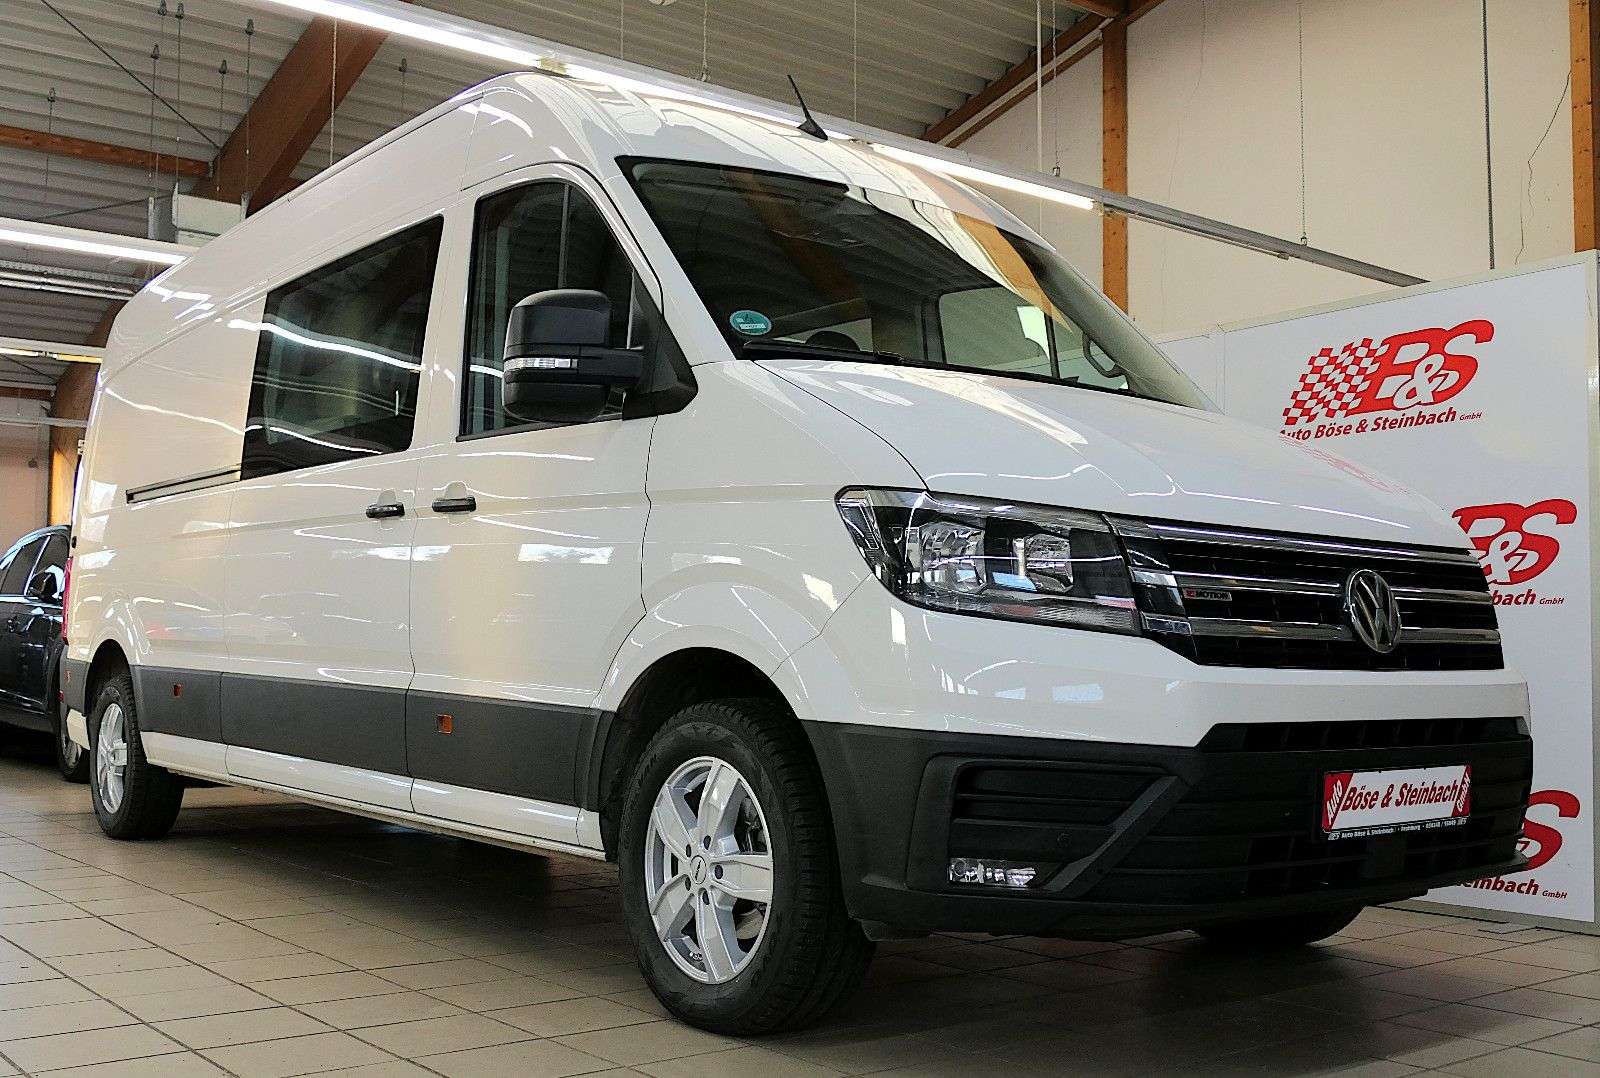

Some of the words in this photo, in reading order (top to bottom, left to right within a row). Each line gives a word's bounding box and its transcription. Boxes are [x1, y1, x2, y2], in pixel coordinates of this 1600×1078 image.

[1314, 422, 1351, 439] Böse
[1355, 417, 1369, 434] &
[1371, 406, 1456, 432] Steinbach
[1459, 411, 1482, 421] GmbH
[1539, 597, 1563, 605] GmbH
[1326, 779, 1343, 826] Auto
[1341, 785, 1379, 811] Böse
[1381, 783, 1395, 808] &
[1395, 779, 1458, 807] Steinbach
[1542, 890, 1567, 899] GmbH
